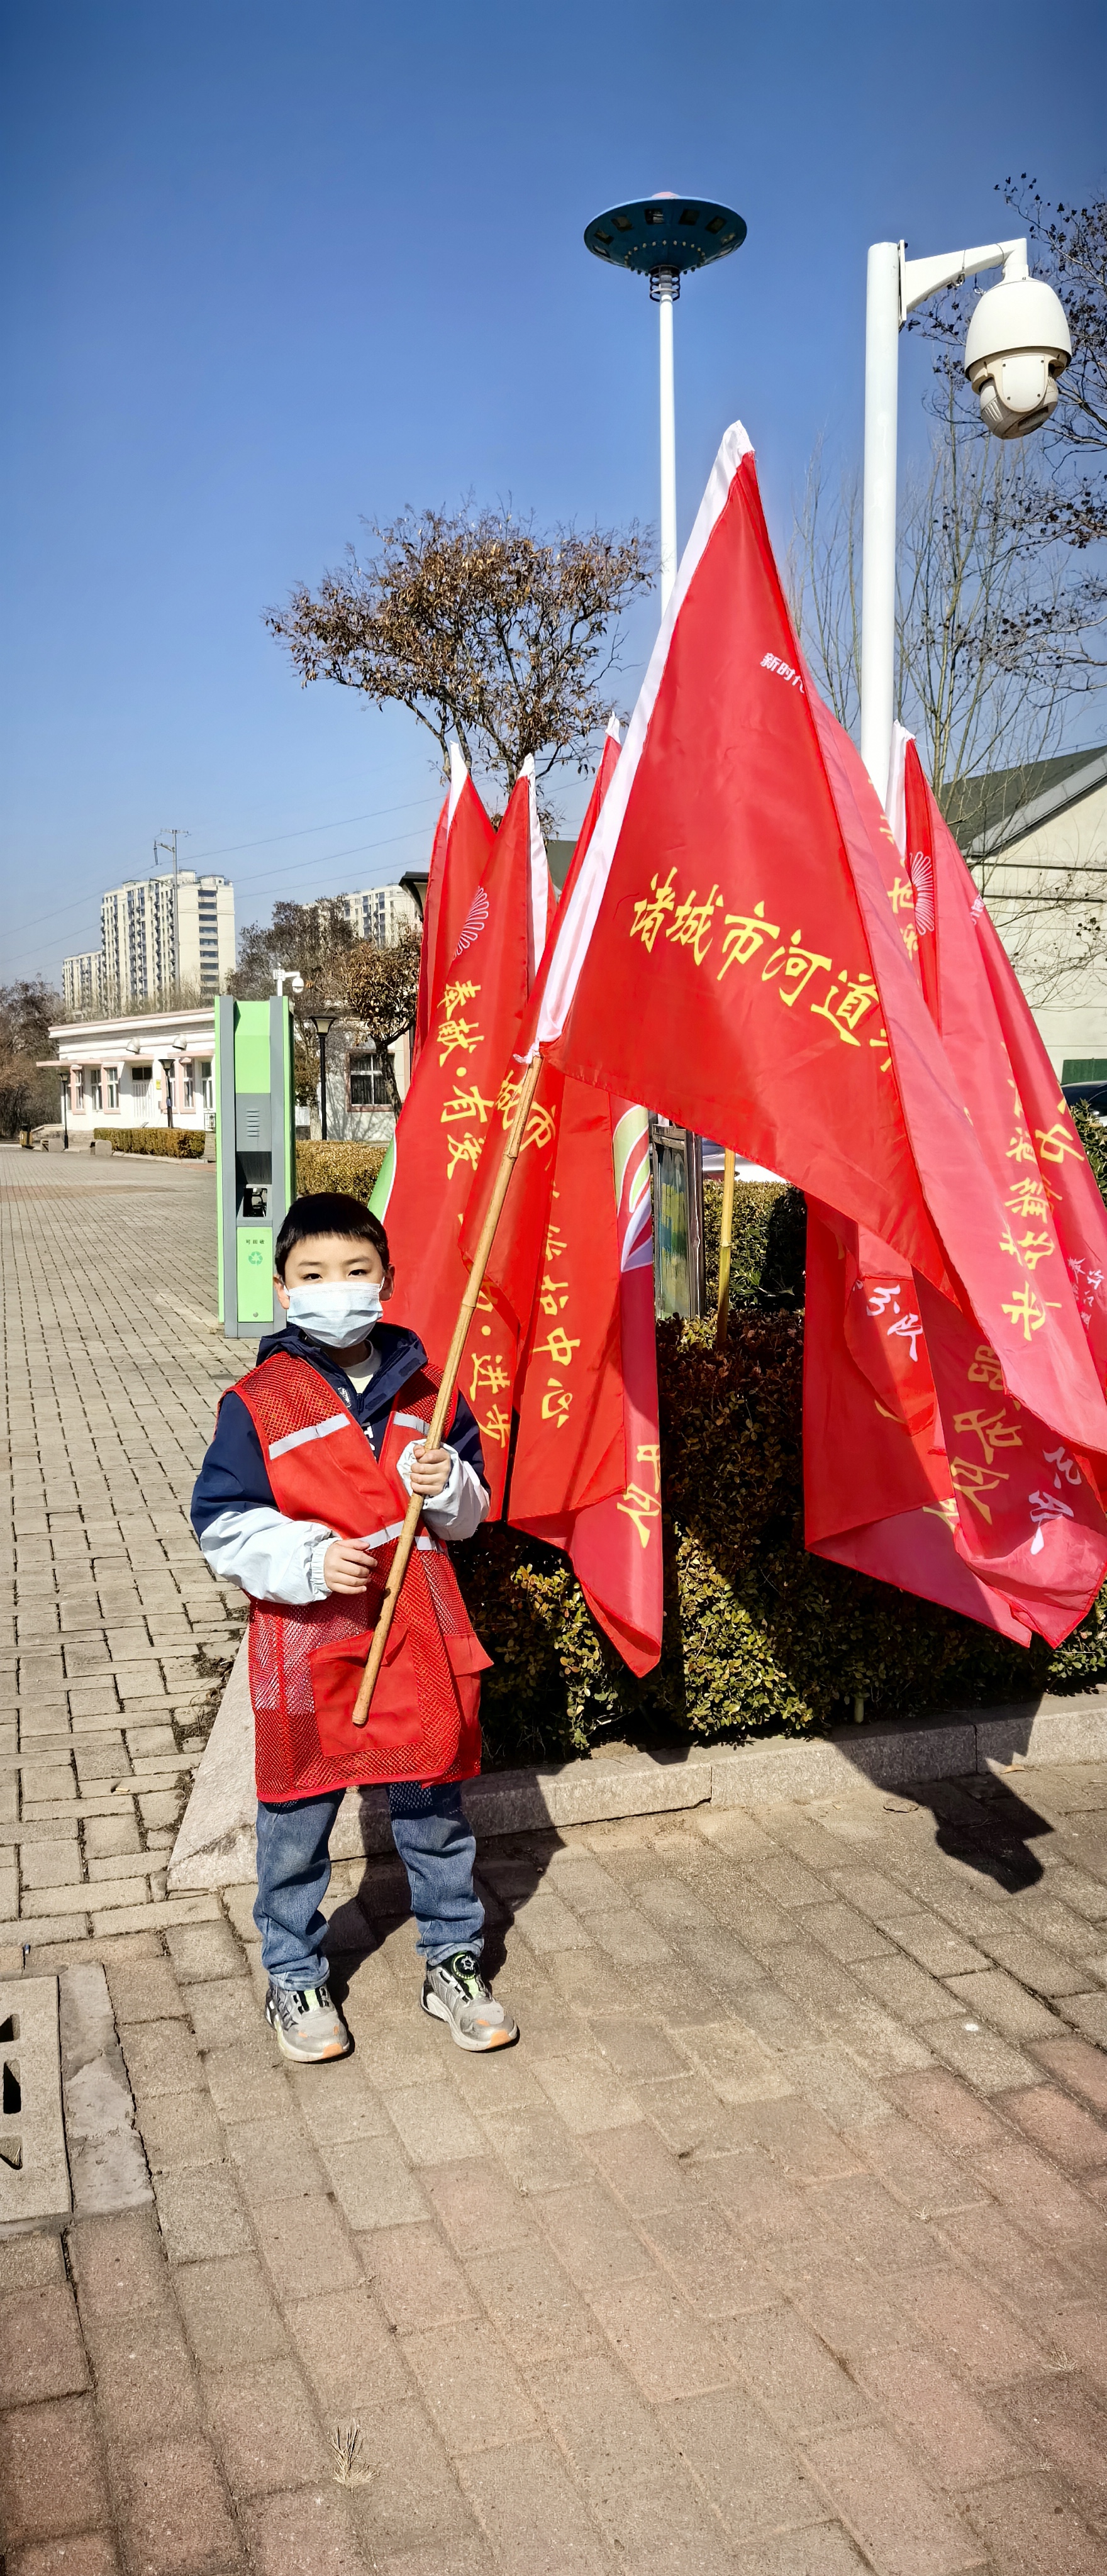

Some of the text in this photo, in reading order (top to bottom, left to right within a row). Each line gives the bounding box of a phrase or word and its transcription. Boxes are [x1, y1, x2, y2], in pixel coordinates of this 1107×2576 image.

[630, 867, 891, 1072] 诸城市河道
